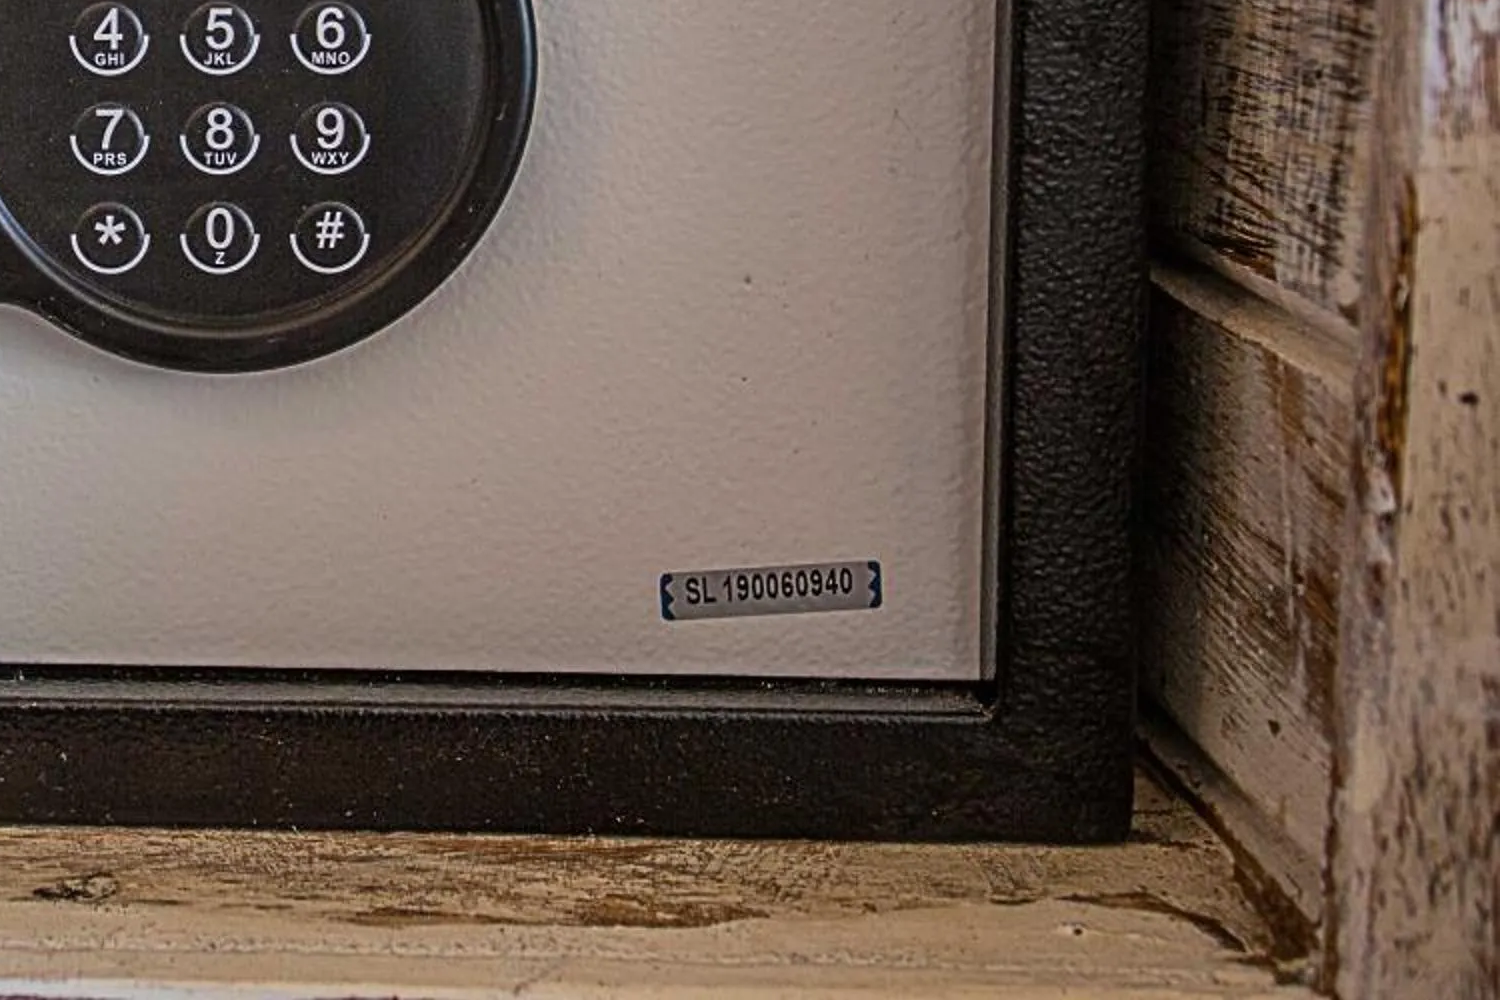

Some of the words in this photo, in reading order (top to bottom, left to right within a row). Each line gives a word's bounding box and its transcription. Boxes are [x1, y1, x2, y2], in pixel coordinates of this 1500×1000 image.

[93, 8, 123, 50] 4
[205, 8, 235, 50] 5
[316, 7, 346, 49] 6
[95, 53, 125, 67] GHI
[203, 53, 236, 67] JKL
[311, 53, 351, 66] MNO
[95, 109, 124, 150] 7
[205, 108, 235, 150] 8
[315, 107, 345, 149] 9
[93, 152, 128, 166] PRS
[204, 151, 237, 166] TUV
[311, 151, 350, 166] WXY
